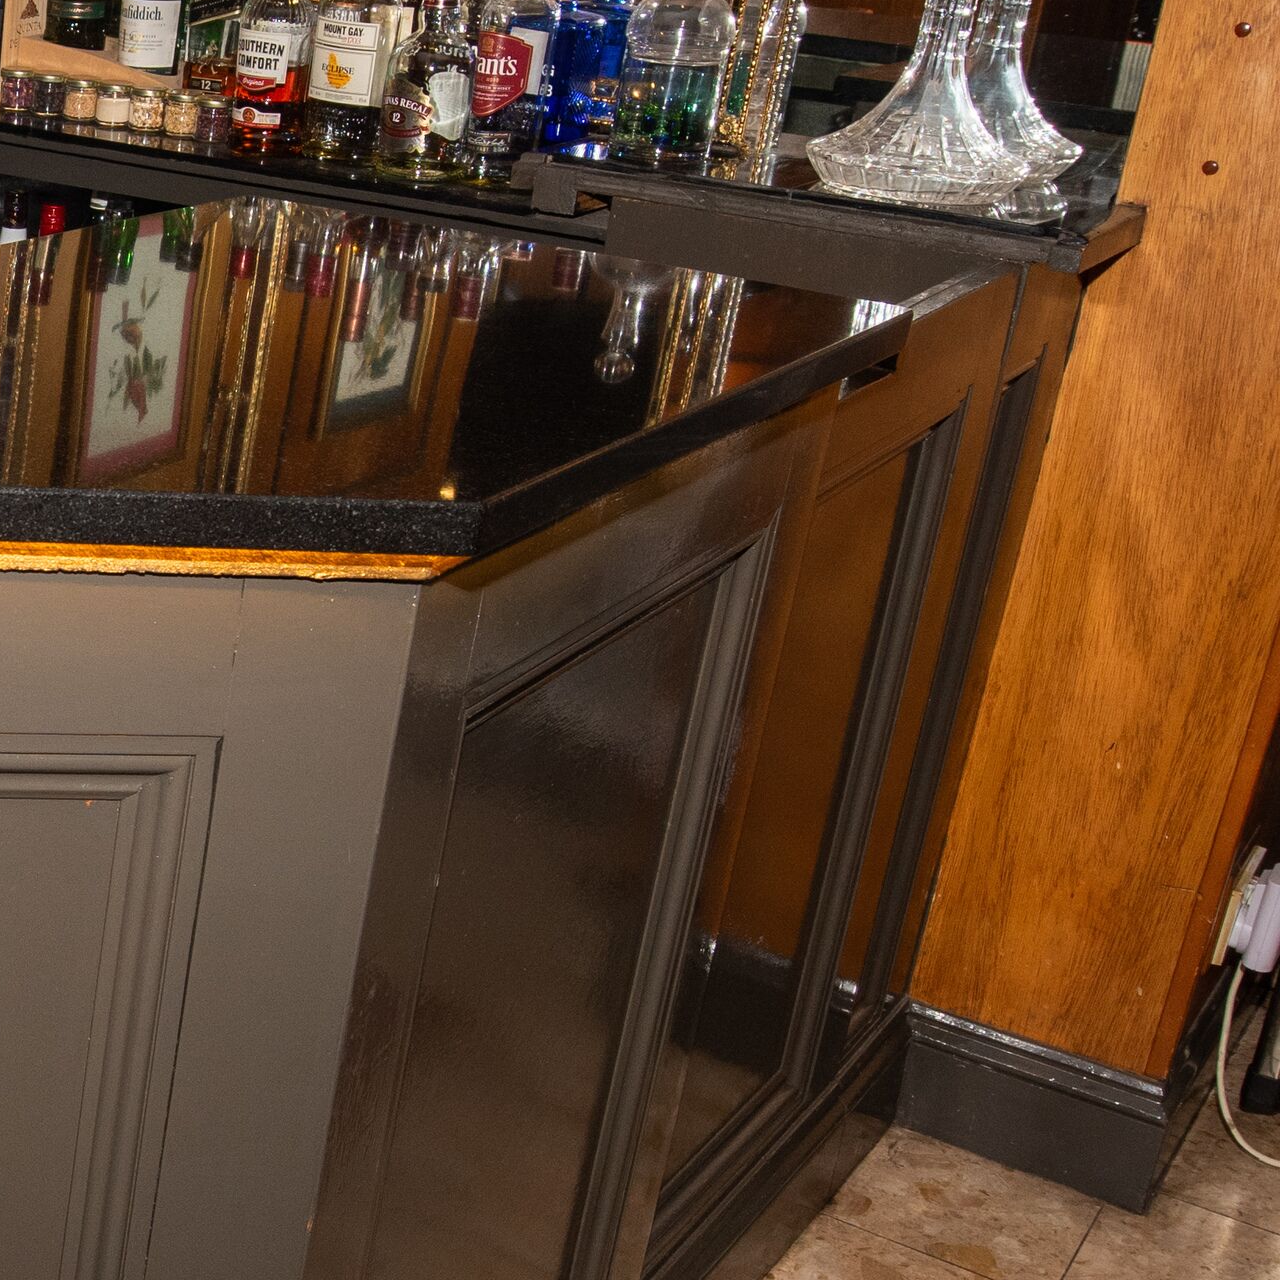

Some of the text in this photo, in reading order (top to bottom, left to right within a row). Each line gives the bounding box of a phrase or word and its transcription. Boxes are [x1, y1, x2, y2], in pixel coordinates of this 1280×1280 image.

[323, 22, 346, 35] MOUNT
[239, 37, 286, 58] SOUTHERN
[238, 53, 280, 72] COMFORT
[321, 62, 355, 75] ECLIPSE
[200, 79, 212, 91] 12
[399, 98, 429, 117] REGAL
[391, 111, 401, 123] 12
